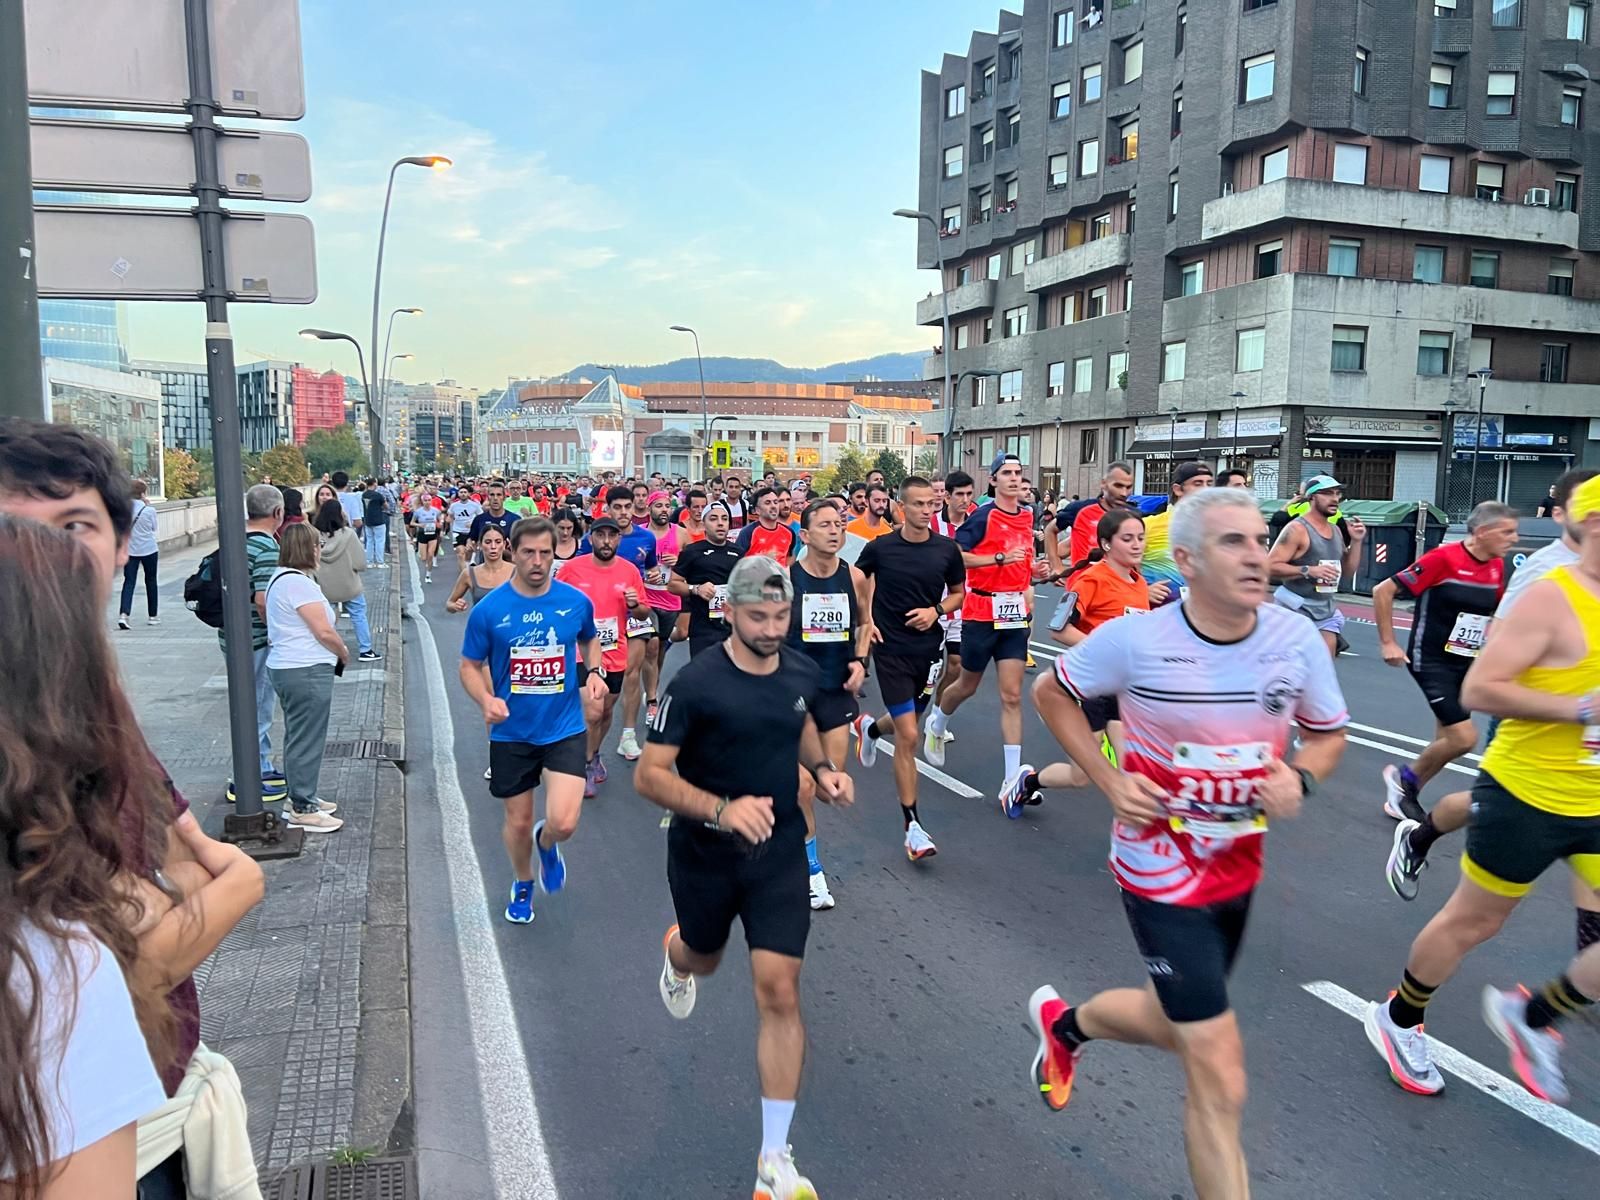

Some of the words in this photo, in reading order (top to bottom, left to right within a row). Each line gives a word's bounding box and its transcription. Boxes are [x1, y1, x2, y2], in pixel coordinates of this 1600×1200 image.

[1302, 448, 1333, 458] BAR
[999, 604, 1020, 614] 1771
[522, 611, 543, 624] edp
[810, 611, 843, 623] 2280
[513, 661, 561, 676] 21019
